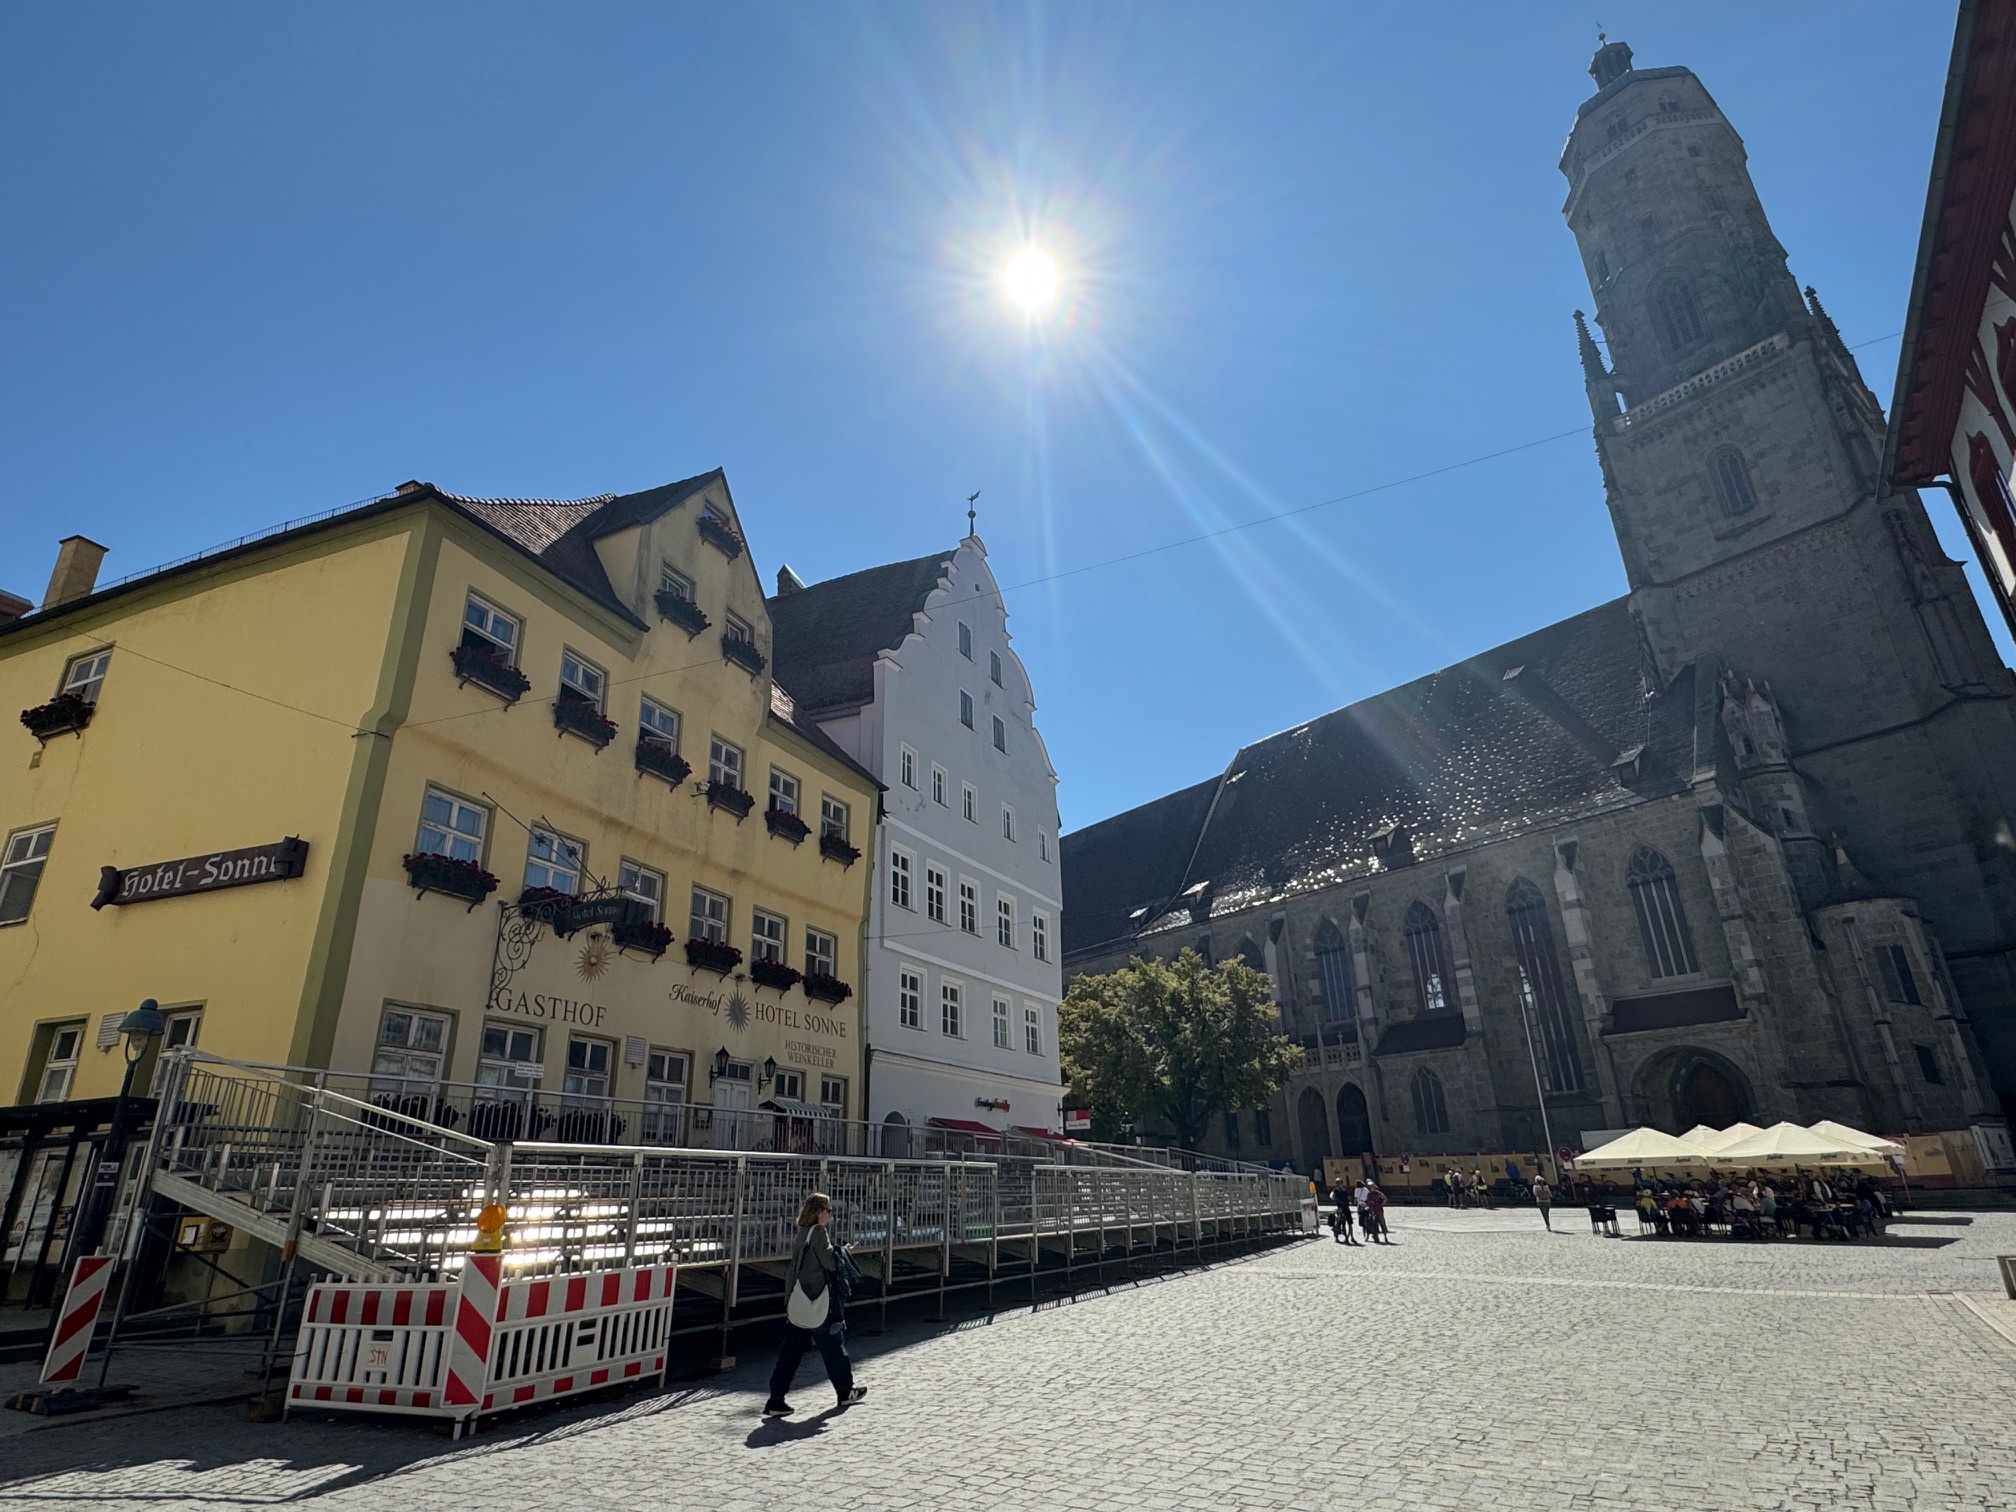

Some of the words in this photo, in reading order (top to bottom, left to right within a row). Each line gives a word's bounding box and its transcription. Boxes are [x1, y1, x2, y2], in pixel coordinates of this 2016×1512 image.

[495, 987, 607, 1027] GASTHOF
[668, 983, 725, 1016] Kaiserhof
[755, 1001, 800, 1029] HOTEL
[804, 1013, 847, 1038] SONNE
[785, 1039, 837, 1058] HISTORISCHER
[787, 1051, 835, 1070] WEINKELLER
